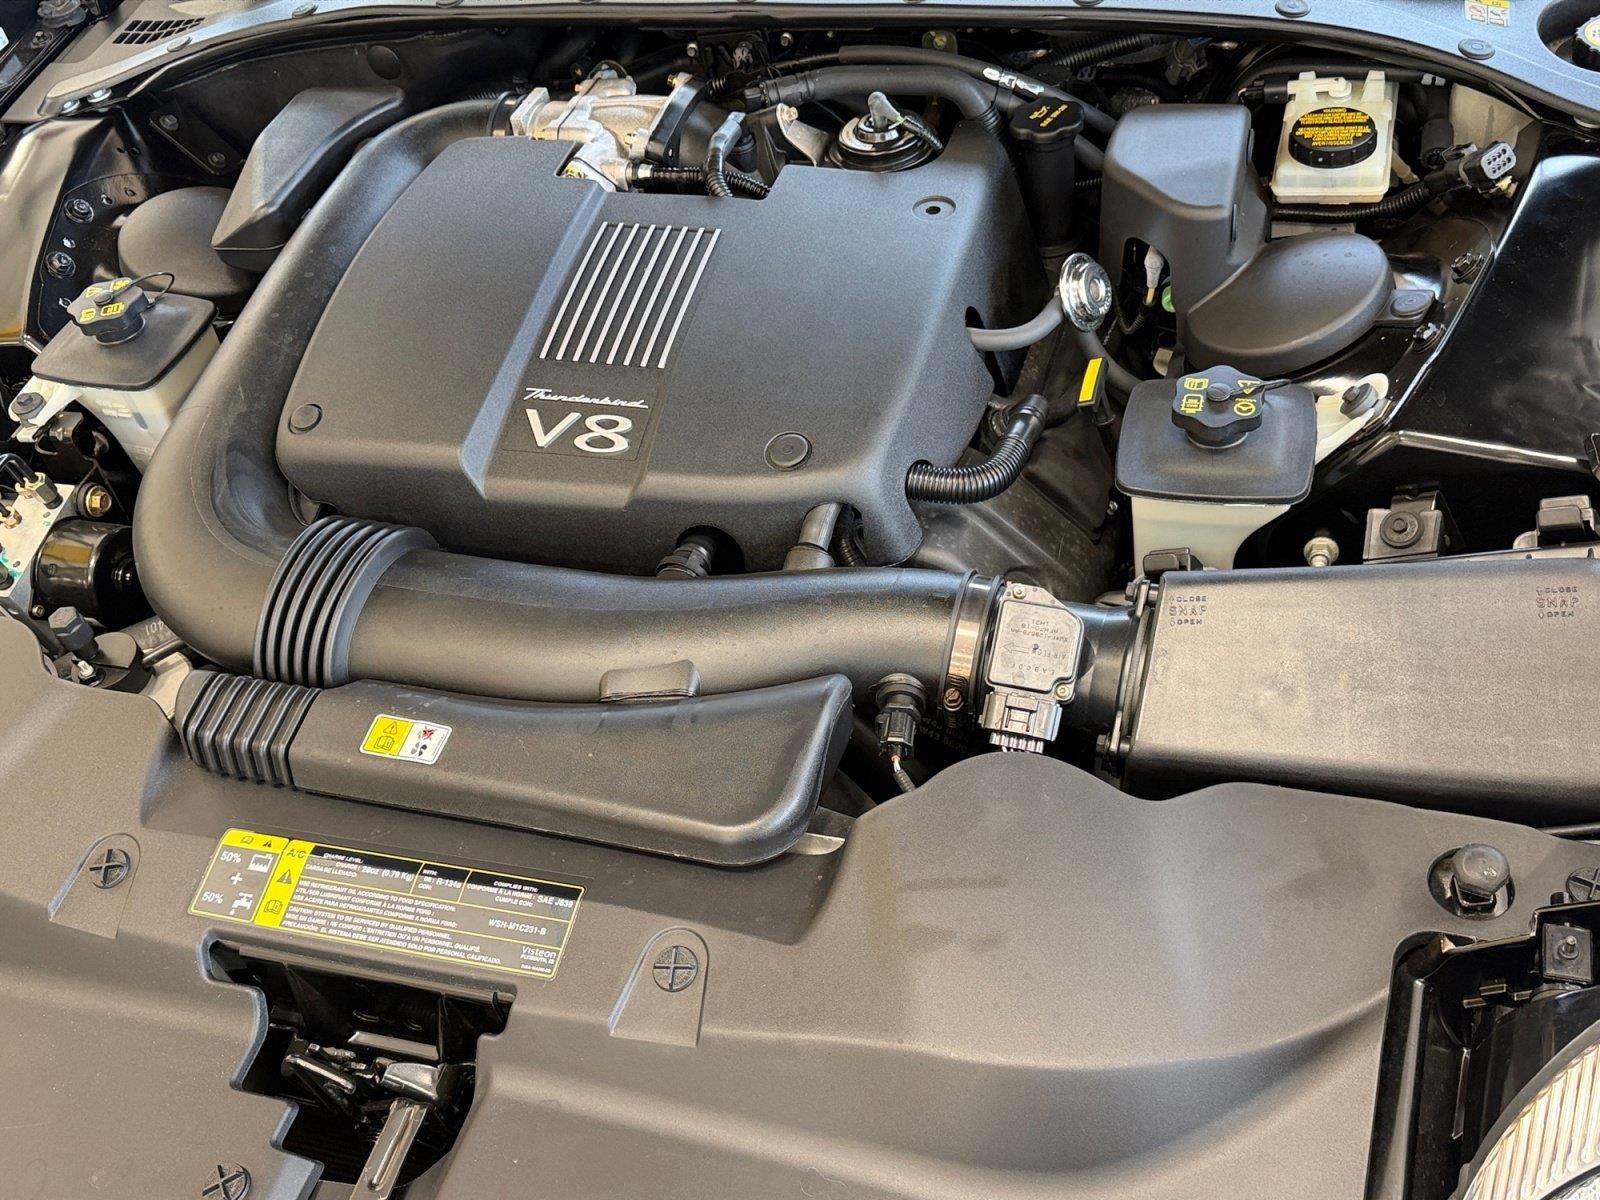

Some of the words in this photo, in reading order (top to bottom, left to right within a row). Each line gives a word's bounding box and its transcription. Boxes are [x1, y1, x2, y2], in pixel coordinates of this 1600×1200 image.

[523, 387, 649, 409] Thunderbird
[525, 408, 633, 454] V8
[1535, 597, 1580, 608] SNAP
[1169, 604, 1208, 616] SNAP
[1546, 610, 1575, 618] OPEN
[220, 851, 241, 863] 50%
[286, 848, 306, 859] A/C
[399, 872, 414, 881] Kg)
[436, 878, 461, 888] R-134a
[494, 881, 521, 889] COMPLIES
[202, 891, 223, 904] 50%
[320, 891, 351, 900] LUBRIFIANT
[351, 897, 381, 906] CONFORME
[358, 890, 389, 899] ACCORDING
[467, 884, 496, 892] CONFORME
[555, 898, 572, 907] J639
[314, 910, 336, 918] SYSTEM
[353, 917, 380, 926] SERVICED
[389, 924, 416, 933] QUALIFIED
[488, 918, 546, 935] WSH-M1C231-B
[421, 937, 453, 947] PERSONNEL
[436, 948, 466, 958] PERSONAL
[521, 946, 556, 958] Visteon
